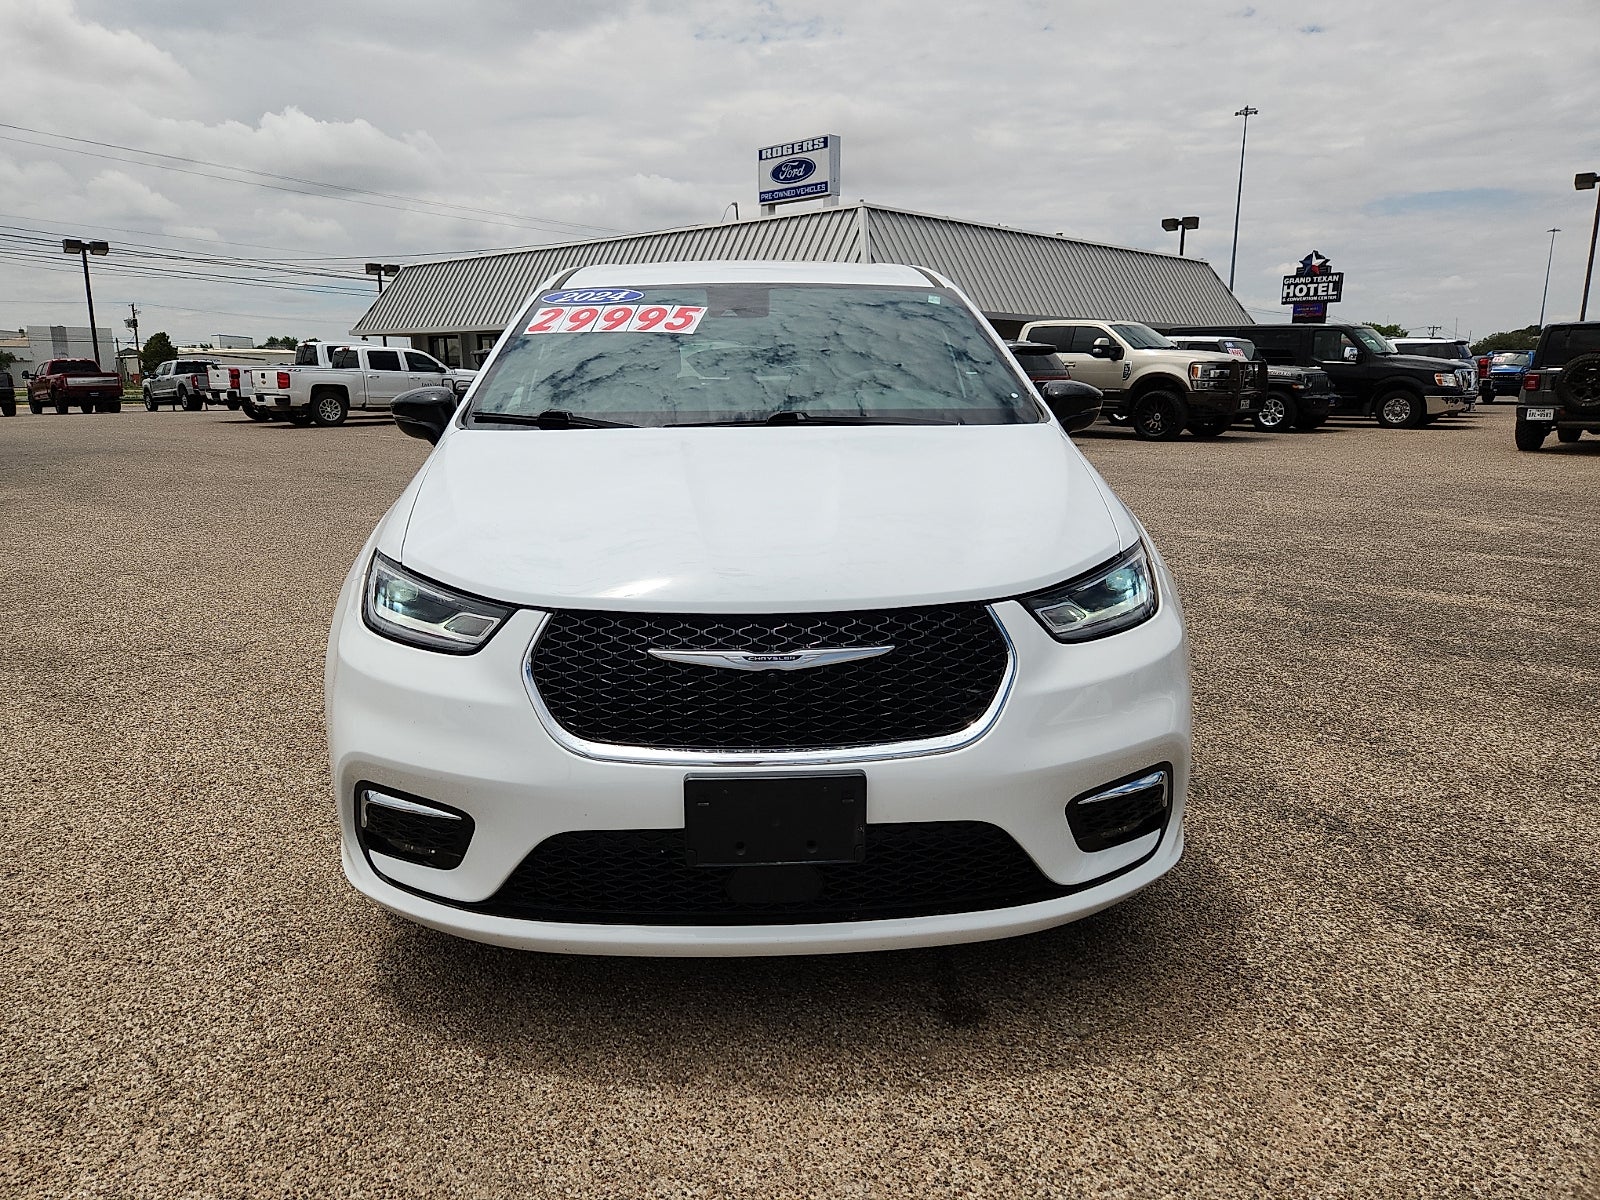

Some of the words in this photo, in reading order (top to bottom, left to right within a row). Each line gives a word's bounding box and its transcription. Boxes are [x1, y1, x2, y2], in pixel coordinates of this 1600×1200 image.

[761, 138, 825, 159] ROGERS
[779, 161, 806, 180] Ford
[760, 189, 796, 201] PRE-OWNED
[797, 183, 826, 195] VEHICLES
[1313, 275, 1340, 283] TEXAN
[557, 290, 630, 303] 2024
[1282, 282, 1338, 297] HOTEL
[528, 307, 704, 332] 29995
